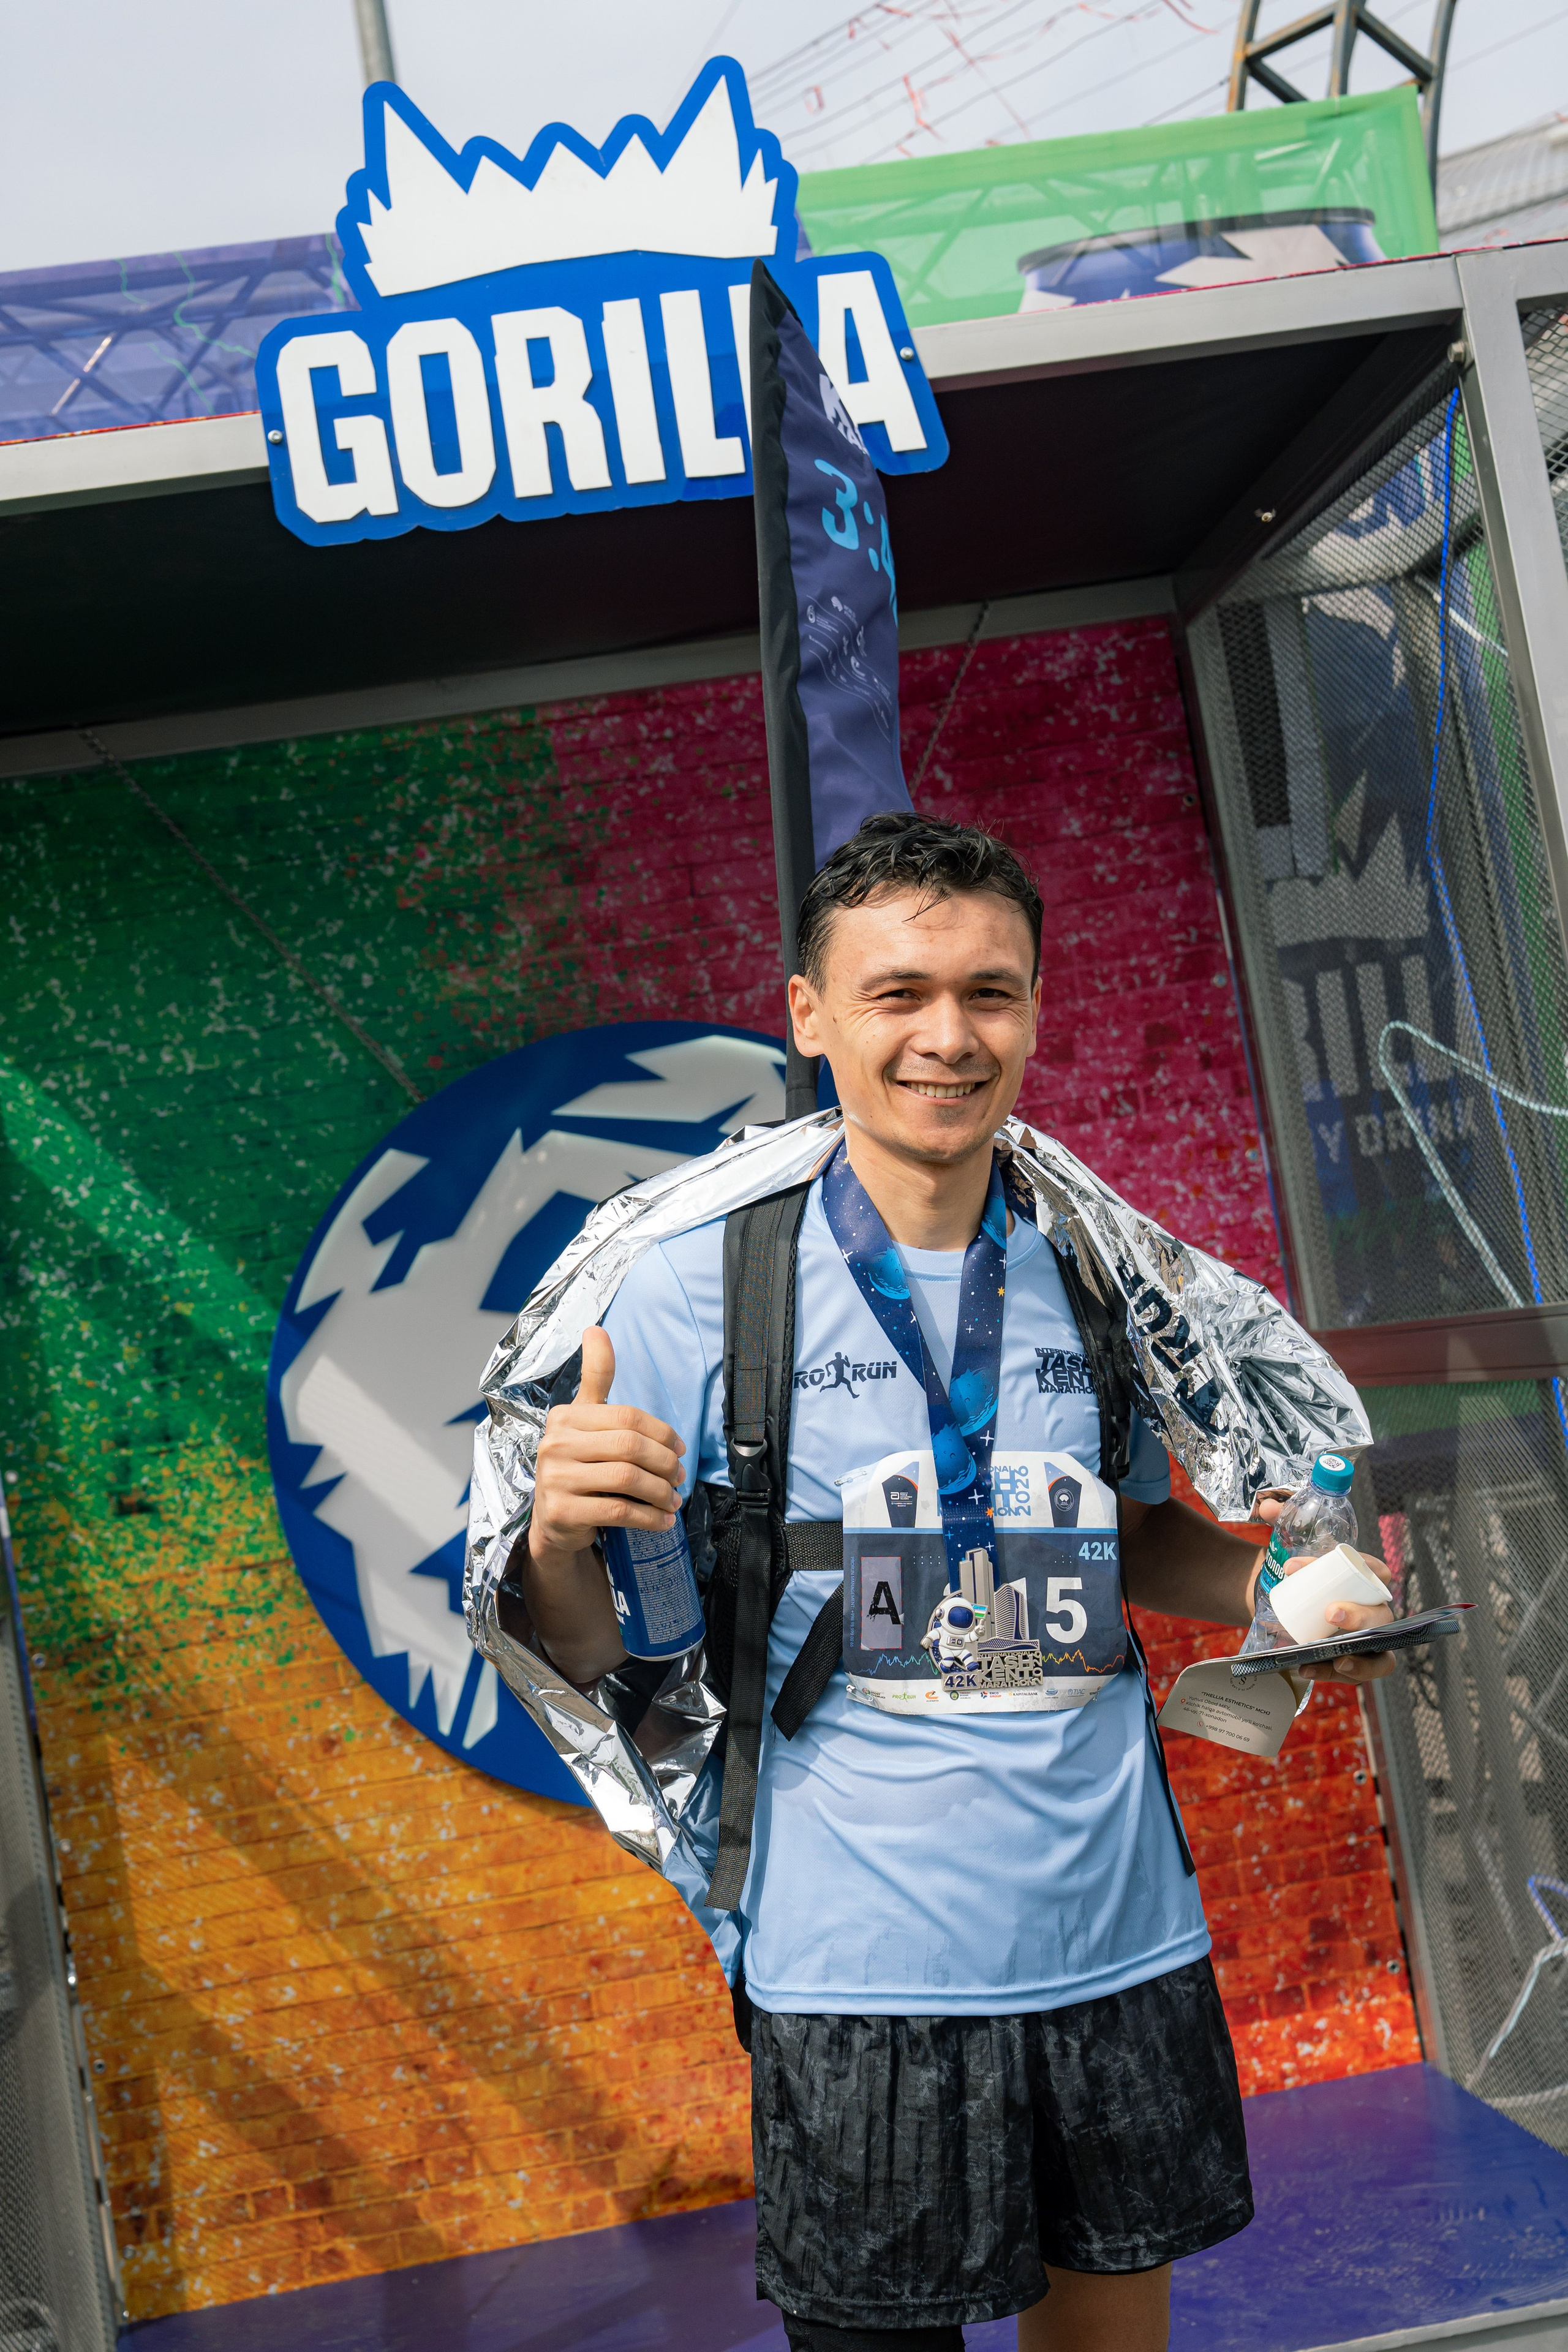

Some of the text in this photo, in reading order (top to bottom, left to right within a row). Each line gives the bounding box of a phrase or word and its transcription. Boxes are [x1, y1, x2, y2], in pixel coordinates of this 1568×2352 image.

[794, 1361, 897, 1389] RO RUN
[1036, 1368, 1094, 1388] KENT
[1014, 1465, 1031, 1516] 2026
[1078, 1542, 1117, 1561] 42K
[866, 1581, 901, 1626] A
[977, 1655, 1034, 1671] TASH
[1031, 1650, 1044, 1685] 2026
[944, 1673, 978, 1688] 42K
[978, 1668, 1031, 1683] KENT
[979, 1679, 1034, 1689] MARATHON
[1216, 1709, 1242, 1721] avtomobil
